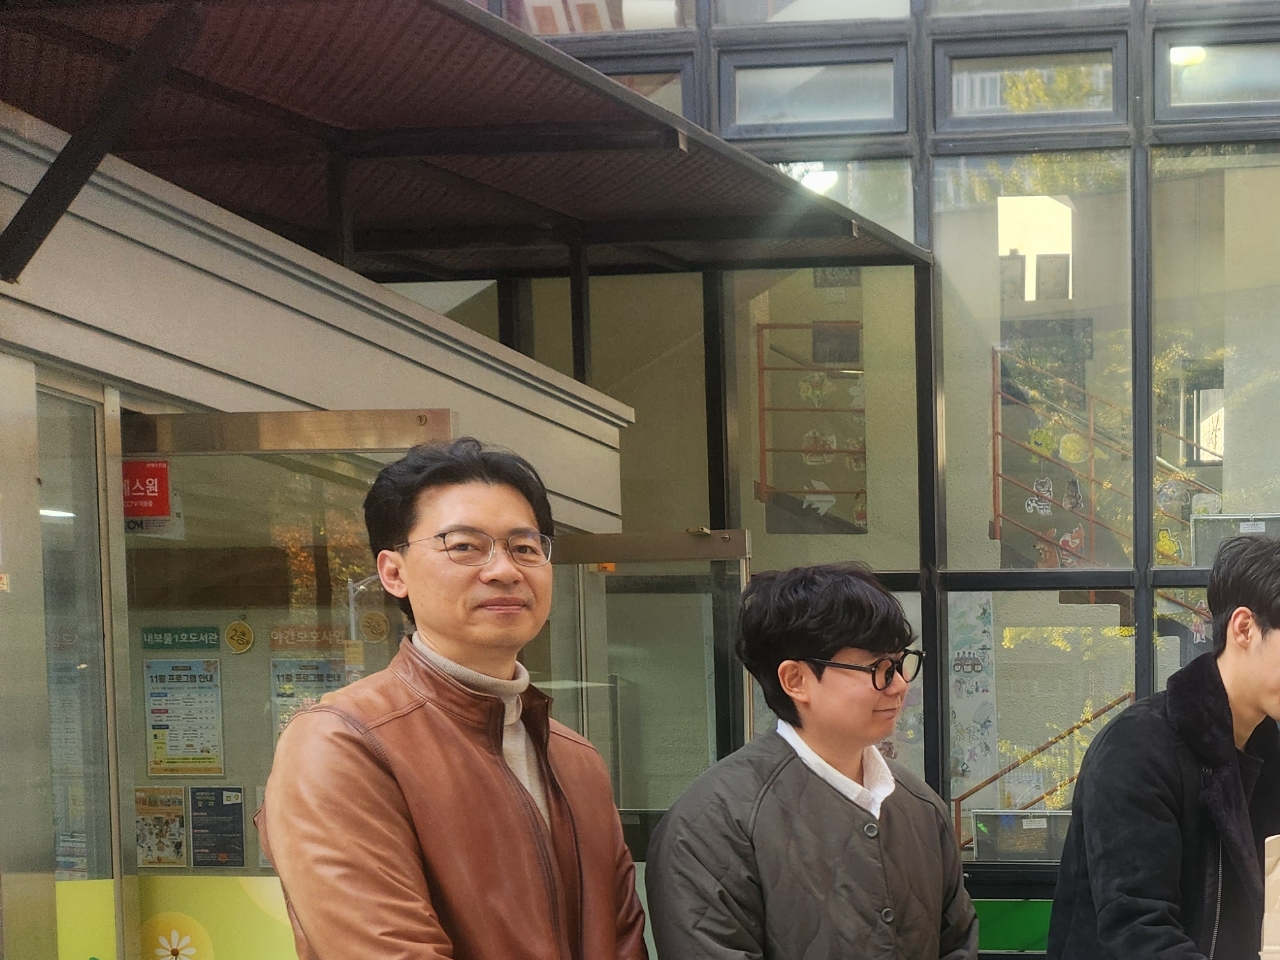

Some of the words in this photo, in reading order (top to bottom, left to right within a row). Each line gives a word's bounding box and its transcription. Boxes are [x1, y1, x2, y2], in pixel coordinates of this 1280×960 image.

[125, 519, 144, 530] OM
[229, 628, 246, 646] 2층
[198, 674, 214, 683] 안내
